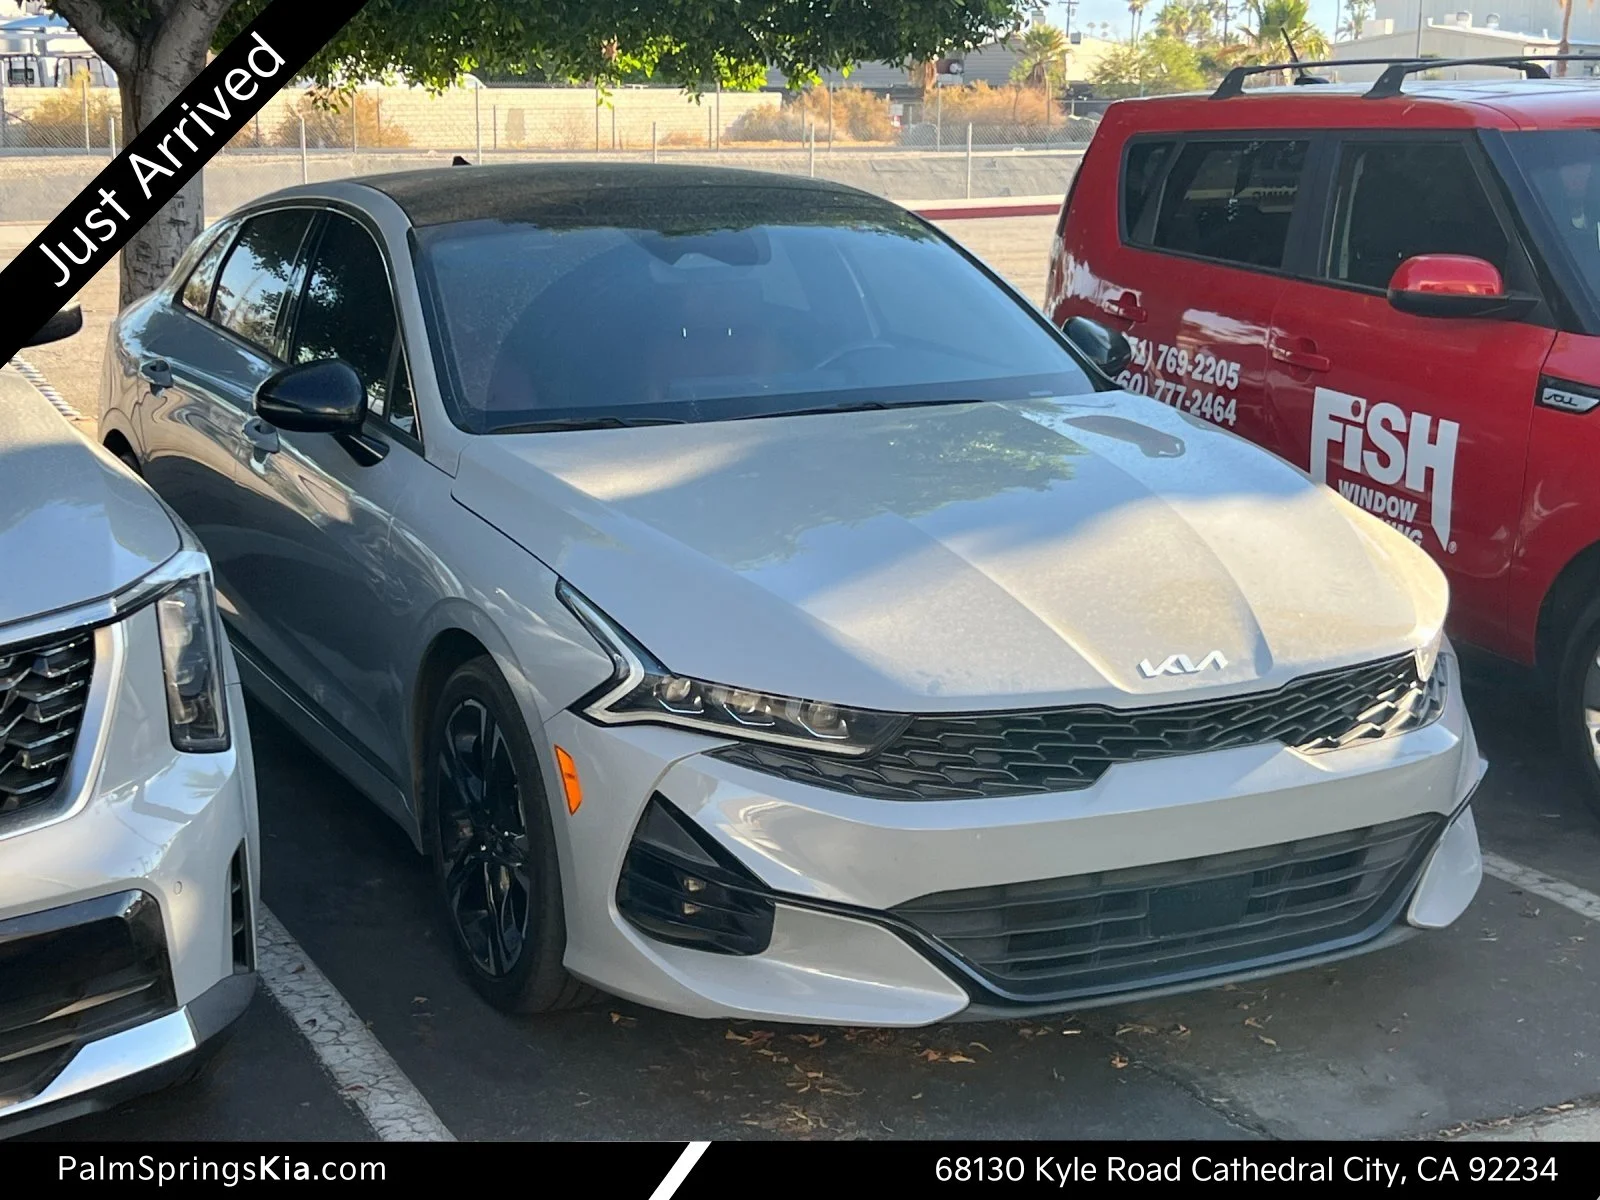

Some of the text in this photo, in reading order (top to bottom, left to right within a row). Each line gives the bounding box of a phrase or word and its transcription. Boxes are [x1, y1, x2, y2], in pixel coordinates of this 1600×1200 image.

[1156, 344, 1240, 390] 769-2205
[1154, 379, 1237, 426] 777-2464
[1338, 479, 1418, 523] WINDOW
